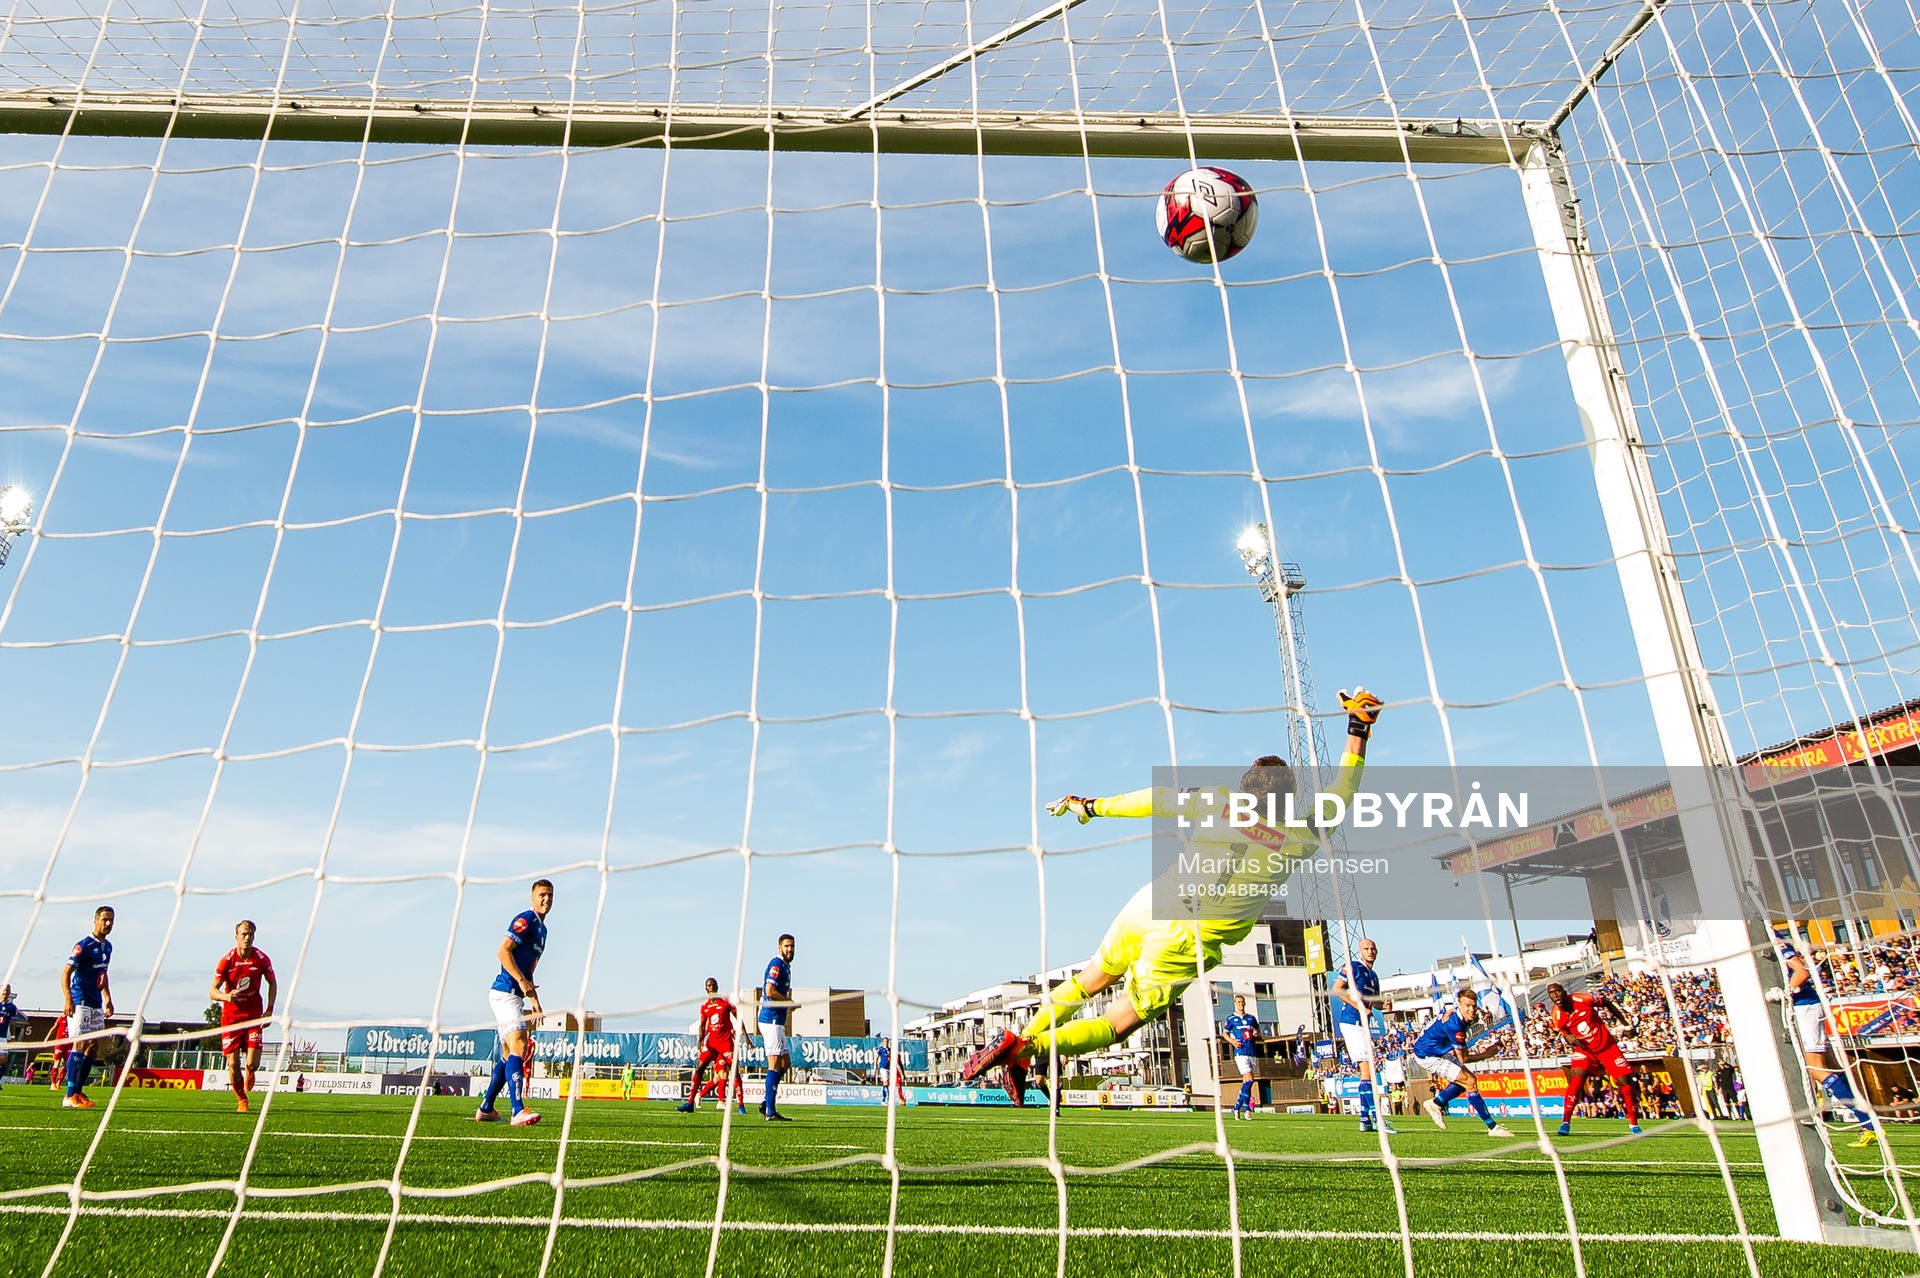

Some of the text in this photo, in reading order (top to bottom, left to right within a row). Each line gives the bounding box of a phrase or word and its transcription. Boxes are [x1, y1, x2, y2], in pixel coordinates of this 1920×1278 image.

[1780, 747, 1829, 775] EXTRA
[1515, 835, 1543, 854] EXTRA
[366, 1029, 476, 1056] Adressevisen
[141, 1078, 197, 1090] EXTRA
[360, 1081, 373, 1089] AS
[786, 1086, 823, 1097] partner
[827, 1087, 859, 1097] overvik
